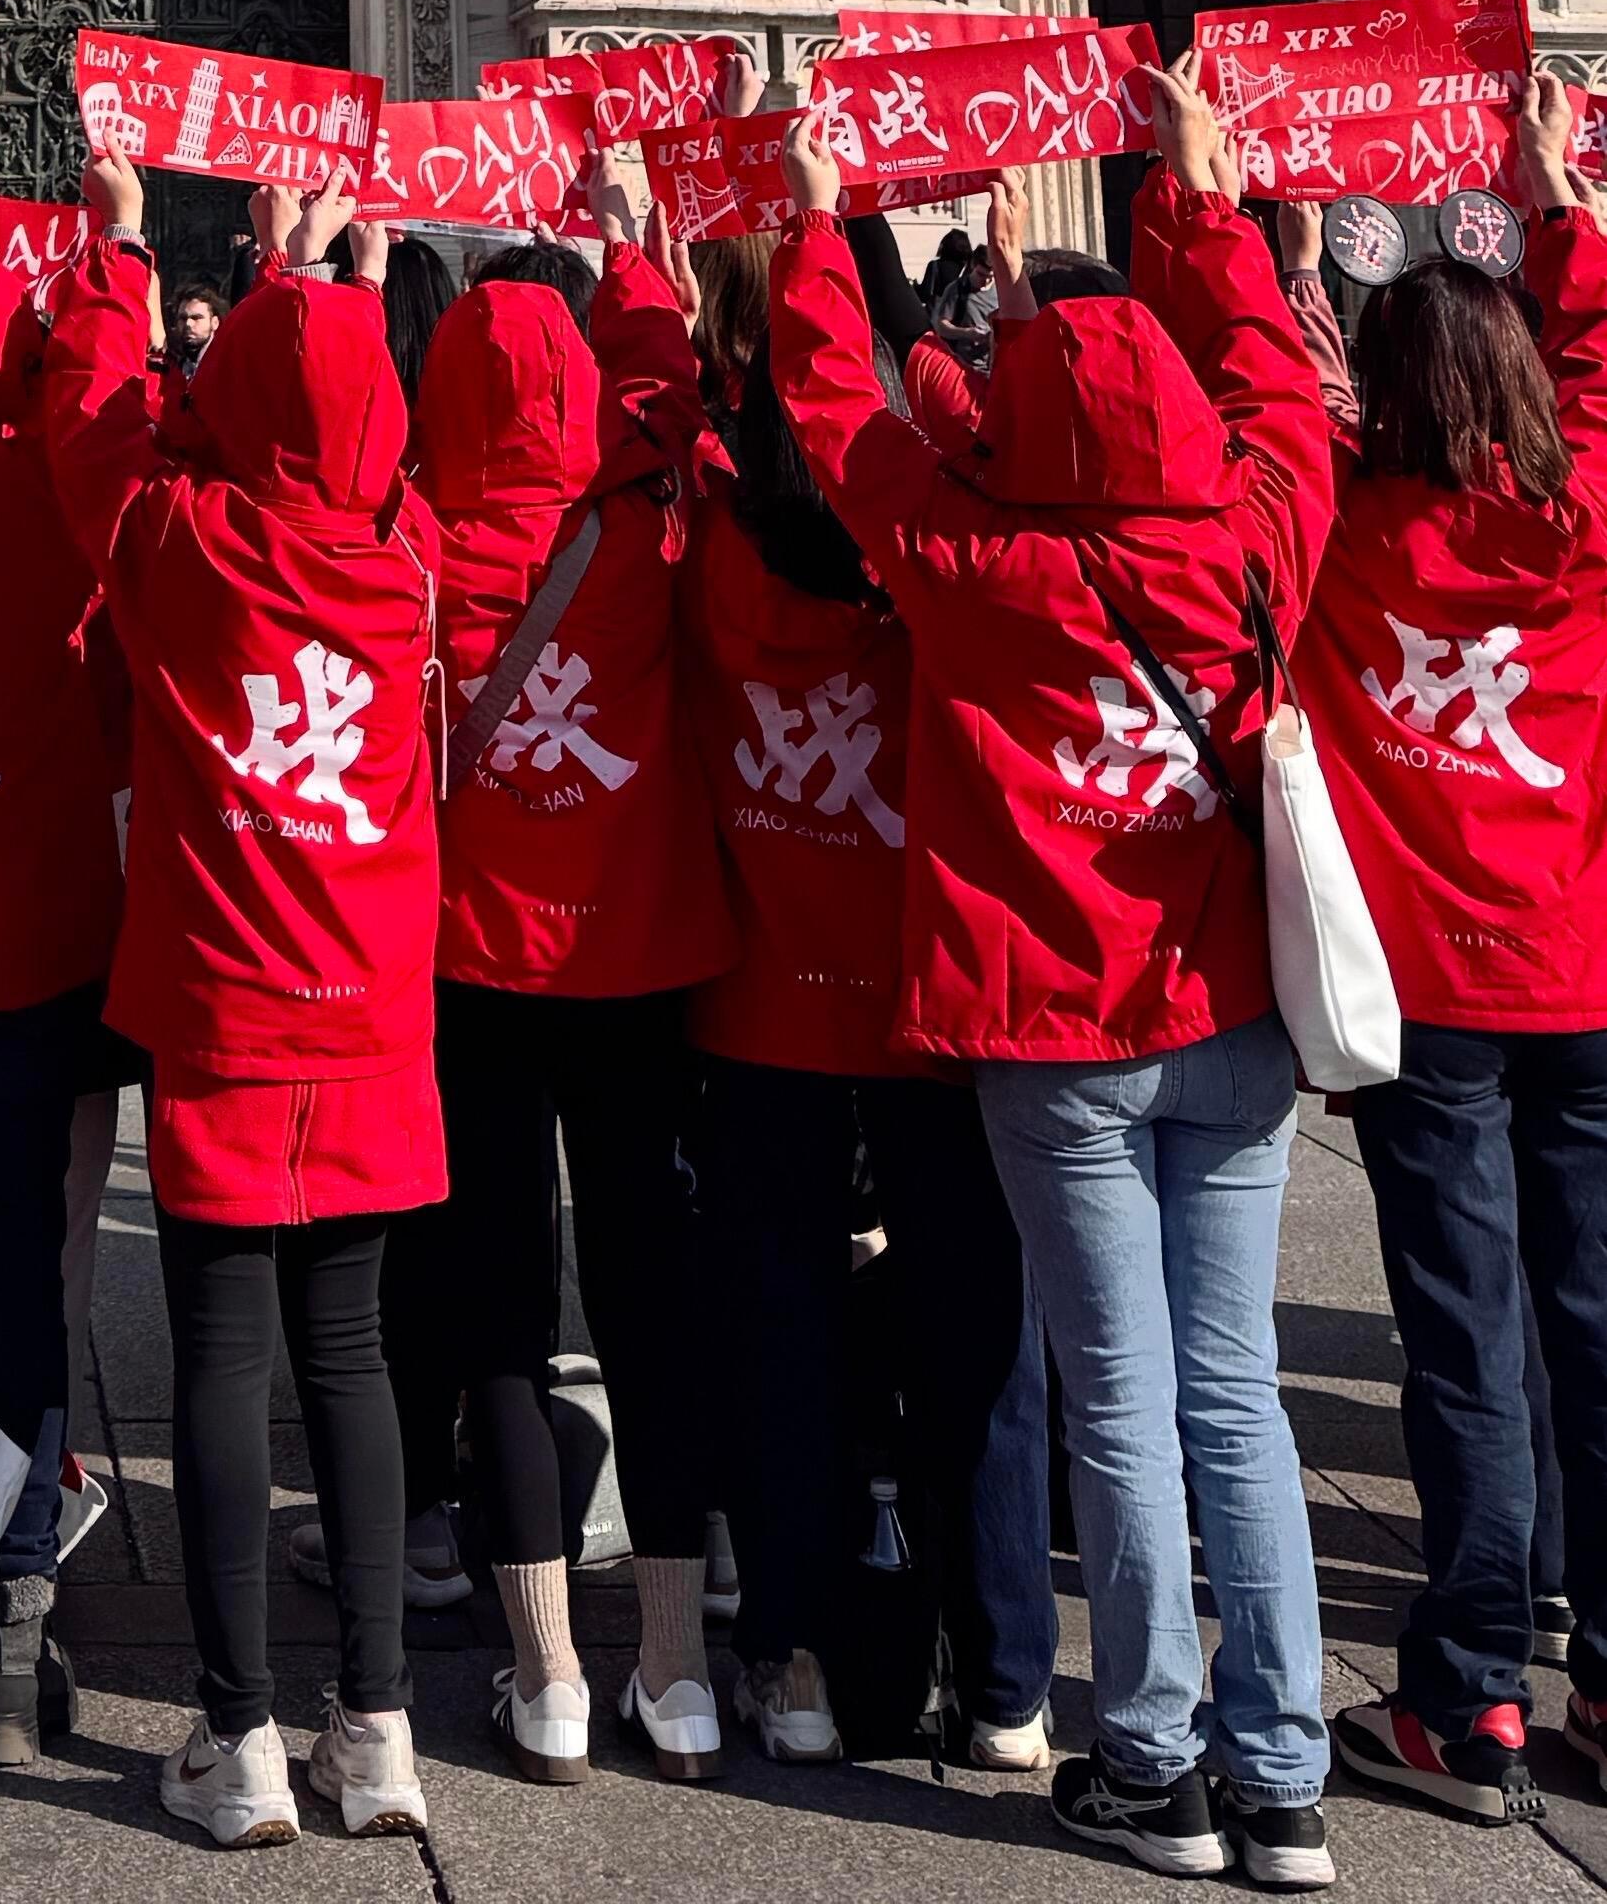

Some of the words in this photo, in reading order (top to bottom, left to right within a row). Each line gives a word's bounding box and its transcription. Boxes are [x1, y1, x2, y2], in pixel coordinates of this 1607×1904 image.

[1200, 20, 1270, 49] USA
[1280, 24, 1357, 54] XFX
[84, 40, 134, 76] Italy
[125, 79, 180, 112] XFX
[222, 89, 319, 138] XIAO
[1294, 82, 1393, 121] XIAO
[809, 68, 950, 168] 肖战
[253, 140, 367, 191] ZHAN
[658, 135, 723, 167] USA
[1360, 610, 1567, 789] 战
[211, 639, 389, 846] 战
[733, 671, 906, 849] 战
[1374, 736, 1429, 769] XIAO
[218, 808, 274, 835] XIAO
[279, 814, 335, 846] ZHAN
[734, 807, 787, 831] XIAO
[1057, 801, 1117, 829] XIAO
[1122, 812, 1185, 833] ZHAN
